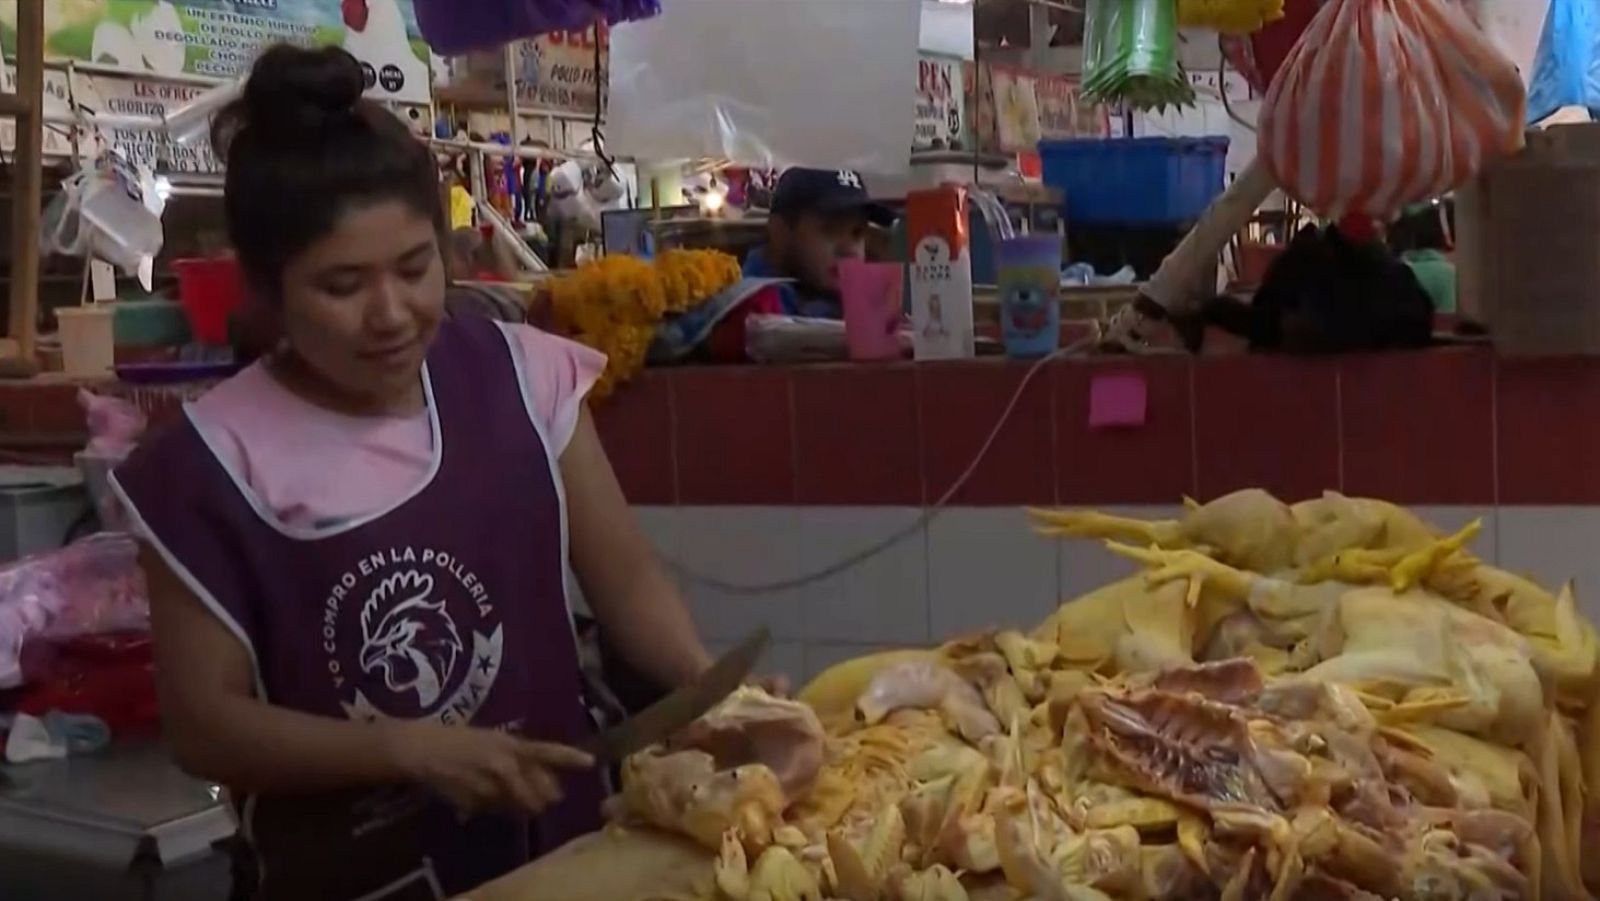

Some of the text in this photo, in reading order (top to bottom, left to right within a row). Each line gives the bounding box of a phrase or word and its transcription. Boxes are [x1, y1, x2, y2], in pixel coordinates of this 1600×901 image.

[187, 9, 206, 20] UN
[154, 30, 237, 48] DEGOLLADO
[200, 23, 217, 34] DE
[222, 26, 263, 39] POLLO
[108, 99, 165, 116] CHORIZO
[323, 546, 494, 688] YO COMPRO EN LA POLLERIA
[440, 683, 484, 725] ENA
